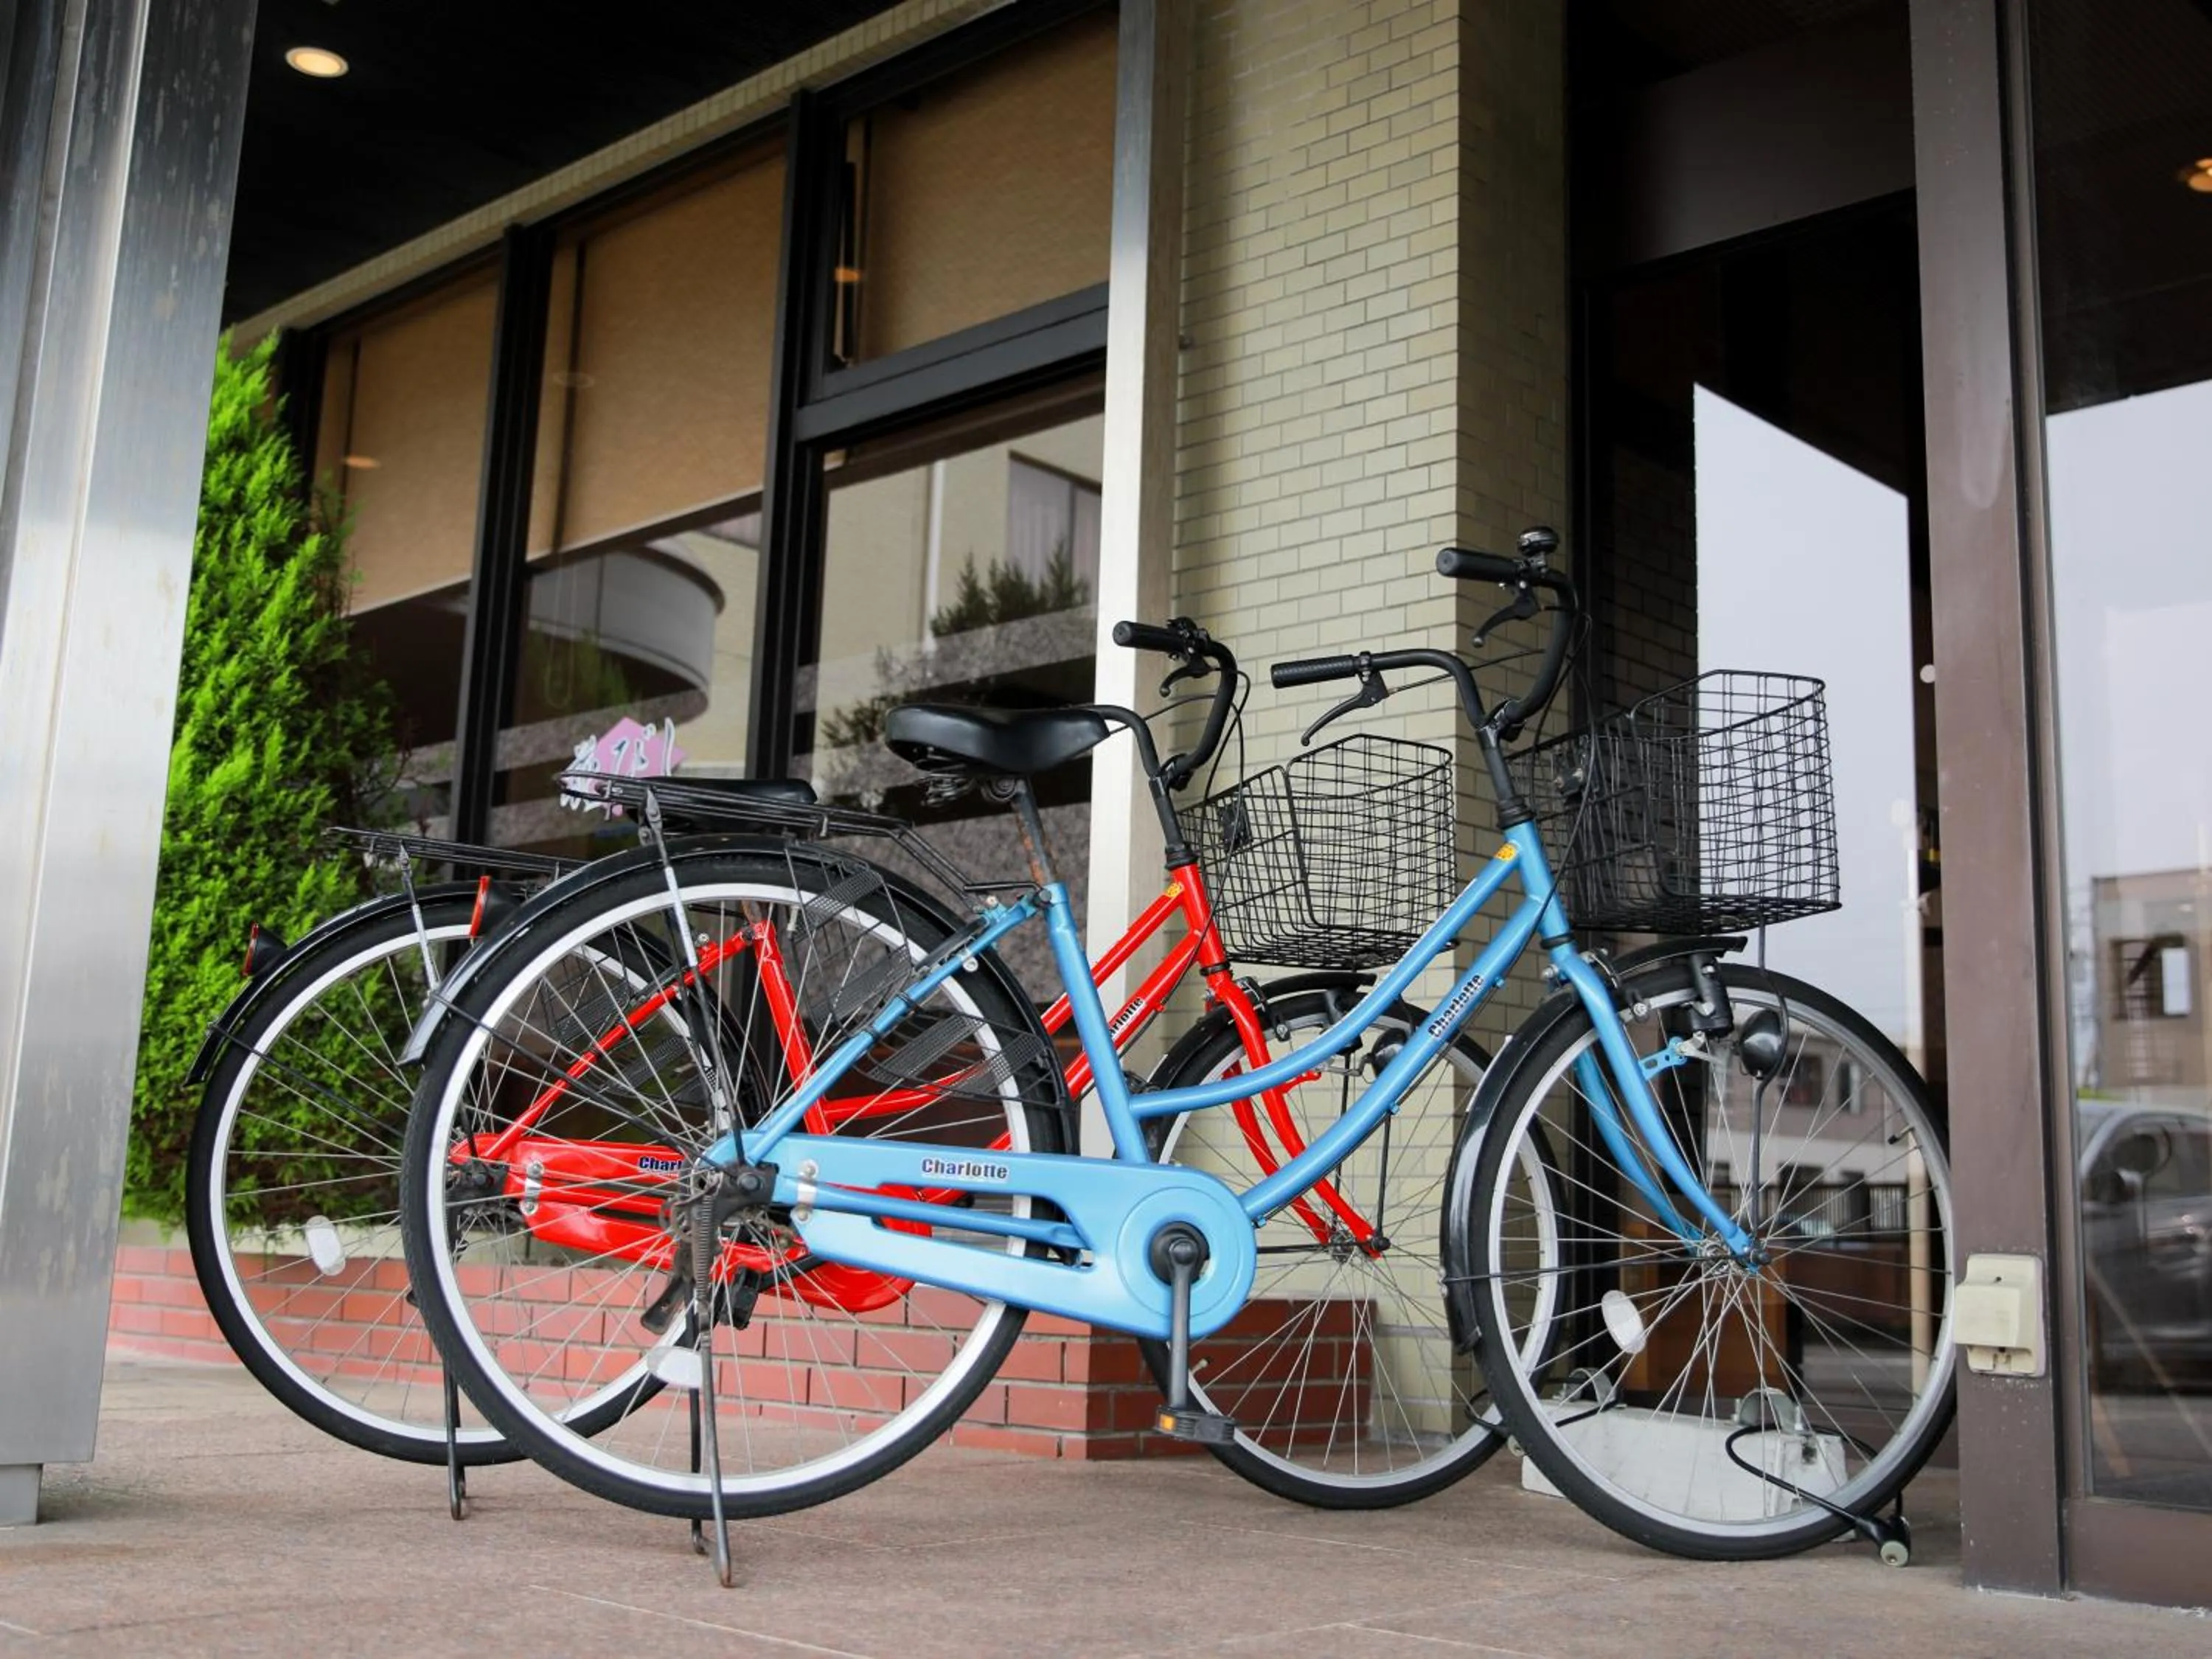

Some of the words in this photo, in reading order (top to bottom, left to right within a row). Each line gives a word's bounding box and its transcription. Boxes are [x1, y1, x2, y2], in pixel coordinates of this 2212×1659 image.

[1427, 975, 1484, 1037] Charlotte
[639, 1155, 683, 1172] Charl
[921, 1158, 1009, 1179] Charlotte
